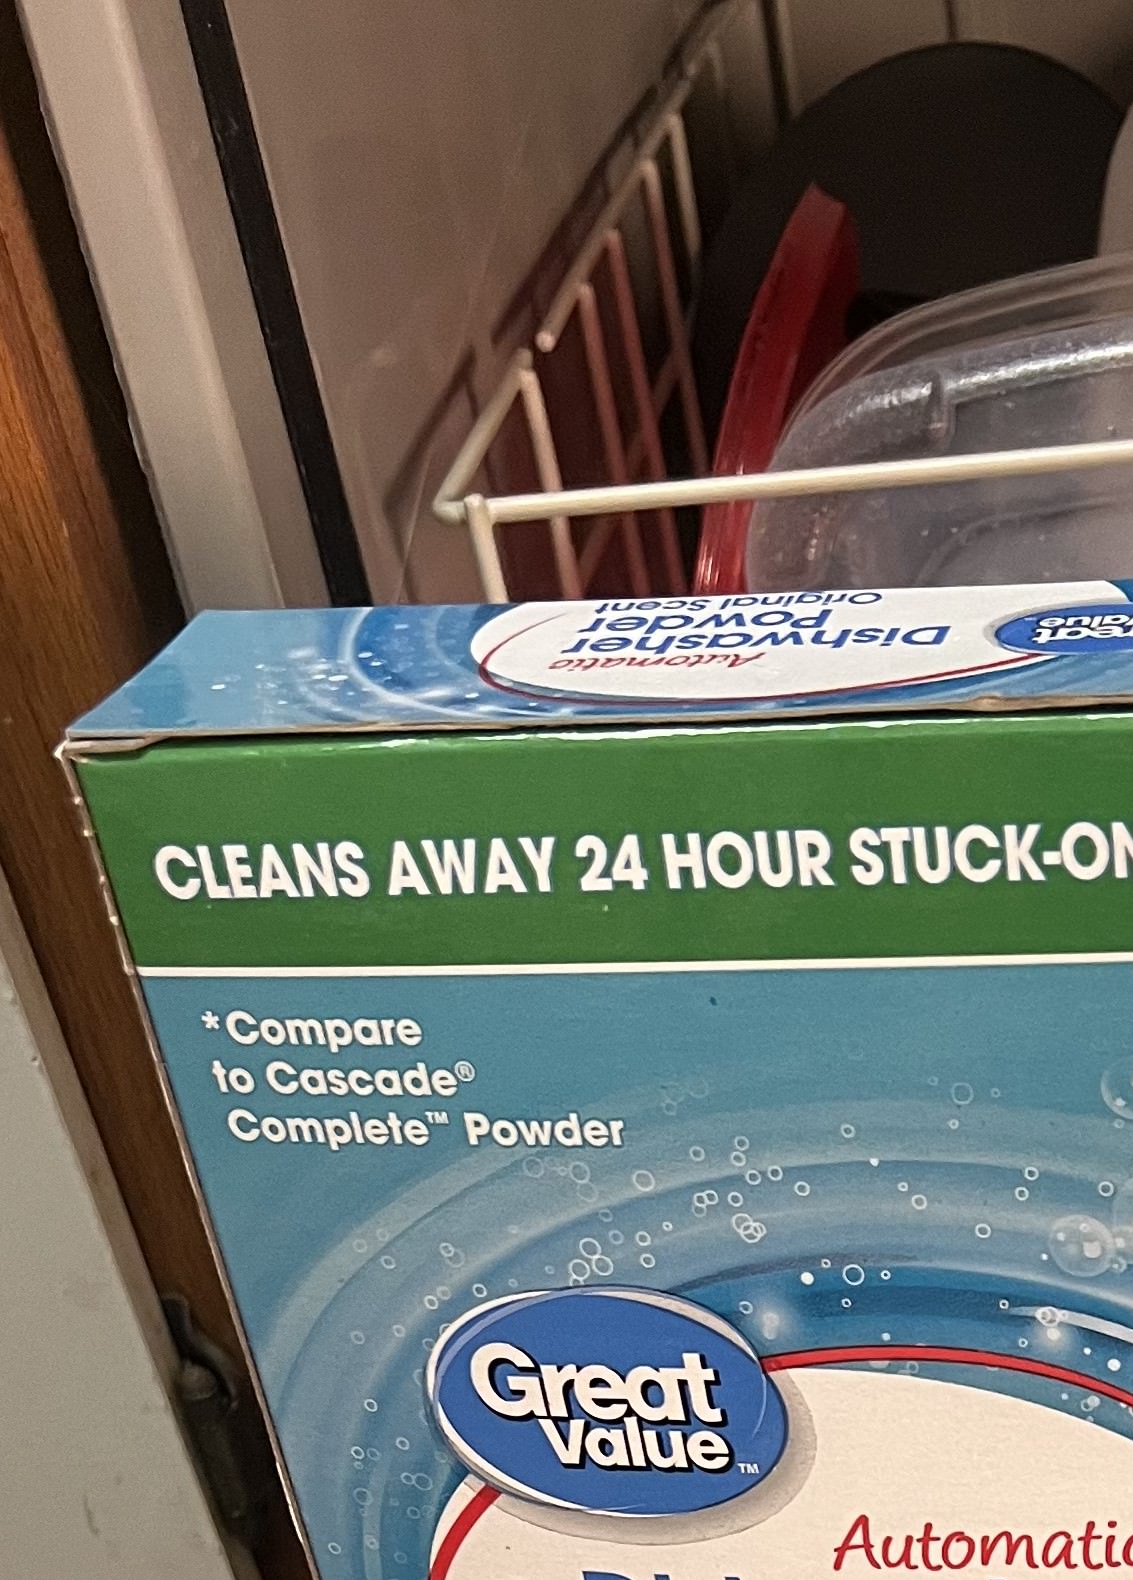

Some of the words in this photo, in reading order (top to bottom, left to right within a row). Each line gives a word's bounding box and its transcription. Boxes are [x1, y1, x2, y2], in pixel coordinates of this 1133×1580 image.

[595, 599, 712, 614] Scent
[720, 592, 882, 609] Original
[577, 609, 833, 634] Powder
[560, 625, 952, 655] Dishwasher
[548, 652, 766, 671] Automatic
[154, 841, 370, 900] CLEANS
[387, 837, 556, 896] AWAY
[576, 833, 648, 892] 24
[660, 829, 836, 889] HOUR
[212, 1060, 256, 1094] to
[463, 1112, 625, 1148] Powder
[470, 1341, 723, 1423] Great
[537, 1416, 731, 1470] Value
